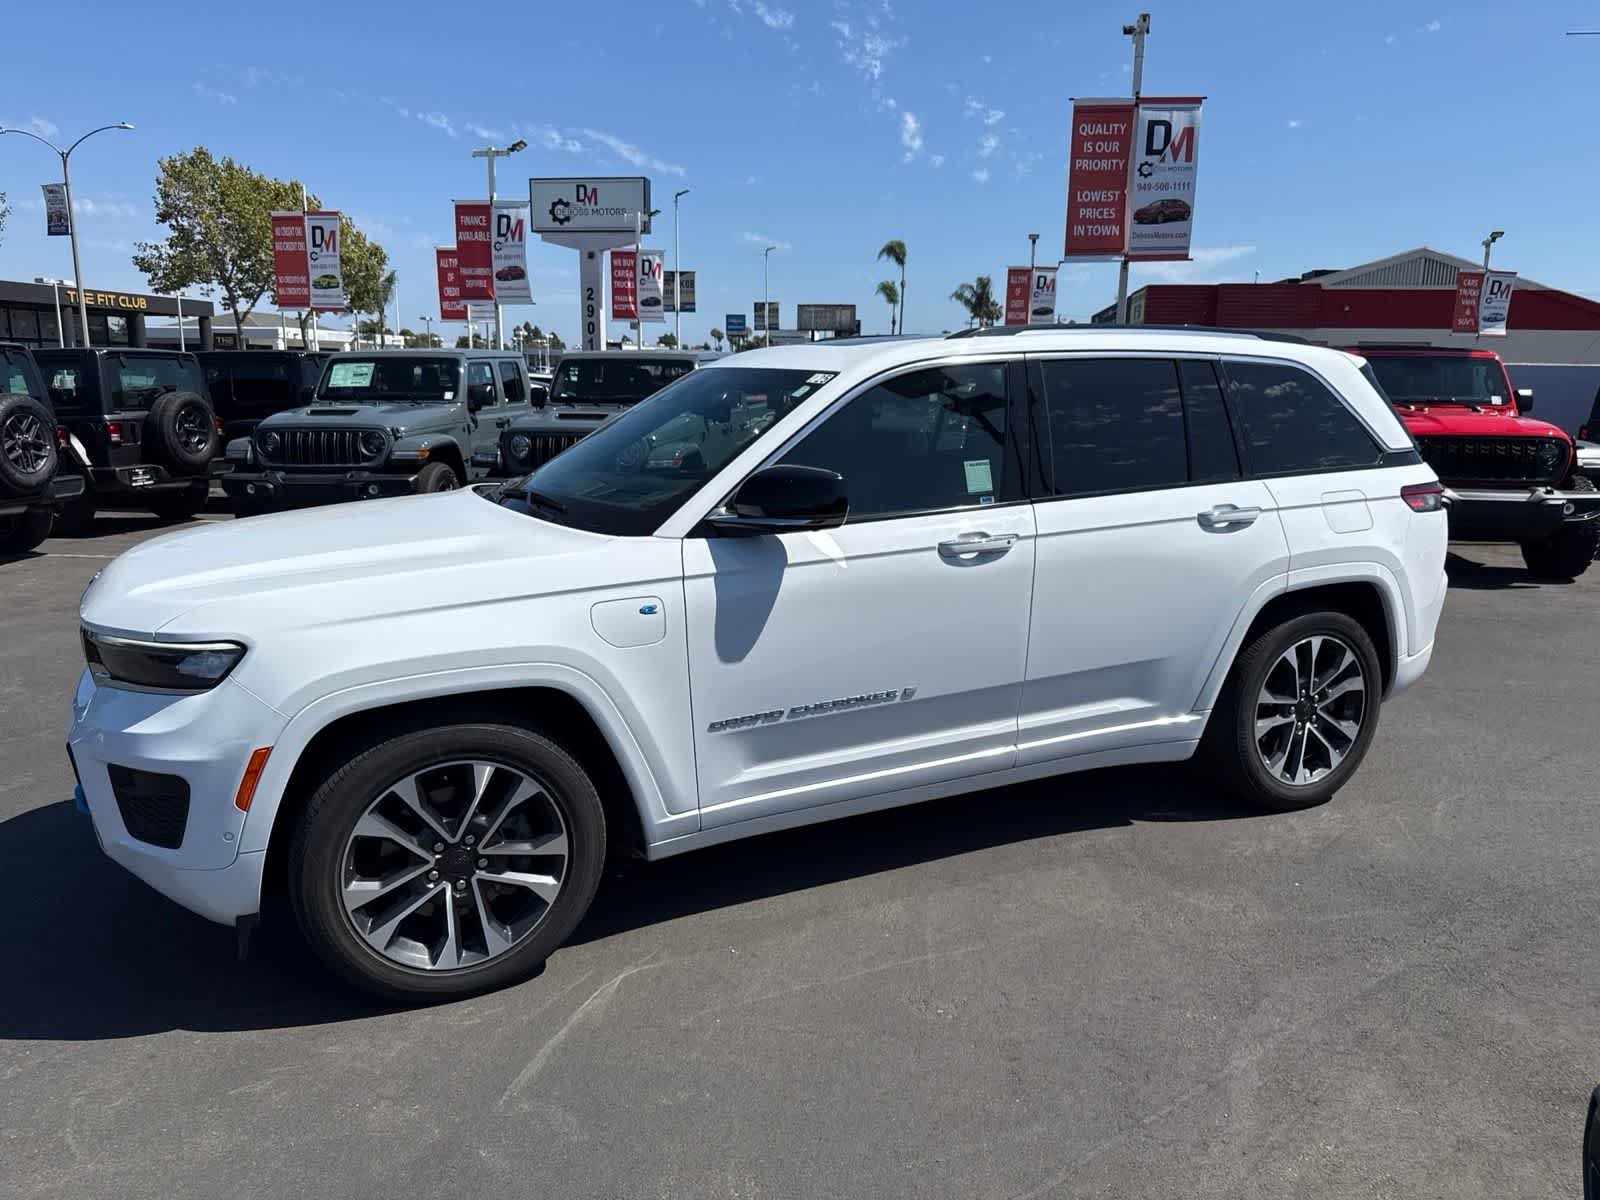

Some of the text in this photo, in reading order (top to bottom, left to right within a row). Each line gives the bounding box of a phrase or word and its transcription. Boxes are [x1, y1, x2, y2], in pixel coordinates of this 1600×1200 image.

[1079, 123, 1127, 136] QUALITY
[1083, 141, 1119, 153] IS OUR
[1075, 159, 1125, 171] PRIORITY
[1077, 190, 1120, 202] LOWEST
[591, 206, 627, 216] MOTORS
[1079, 208, 1116, 219] PRICES
[460, 215, 487, 226] FINANCE
[1073, 225, 1120, 236] IN TOWN
[458, 231, 492, 242] AVAILABLE
[96, 293, 116, 306] FIT
[118, 296, 147, 309] CLUB
